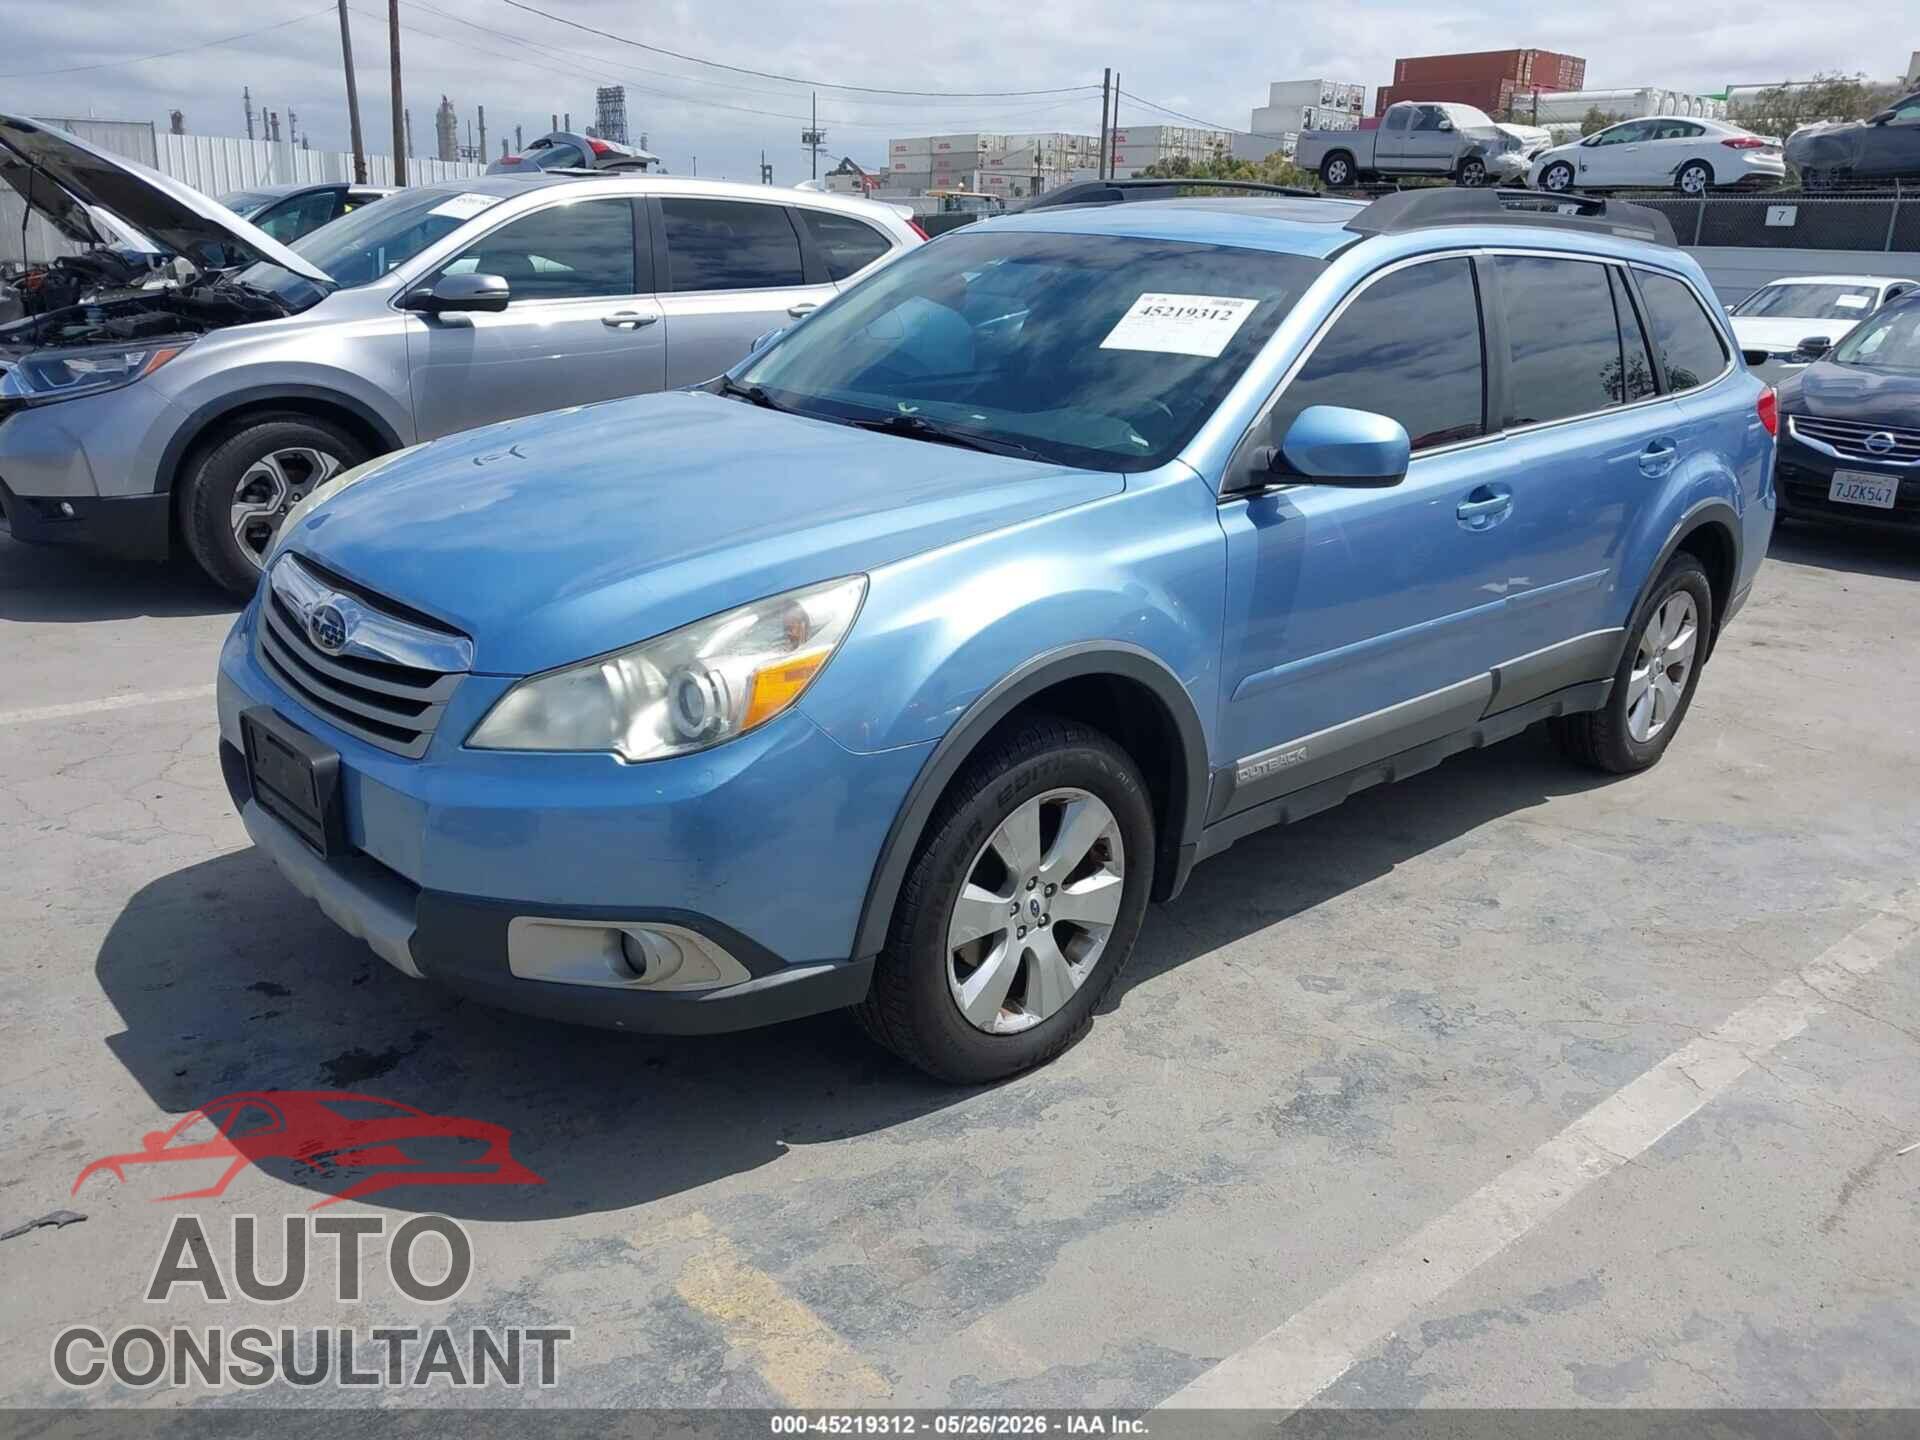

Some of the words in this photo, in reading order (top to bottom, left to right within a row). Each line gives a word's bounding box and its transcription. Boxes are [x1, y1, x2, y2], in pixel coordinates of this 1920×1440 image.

[1777, 210, 1786, 221] 7
[1140, 304, 1233, 321] 45219312
[1834, 481, 1892, 504] 7JZK547
[1235, 746, 1312, 786] OUTBACK
